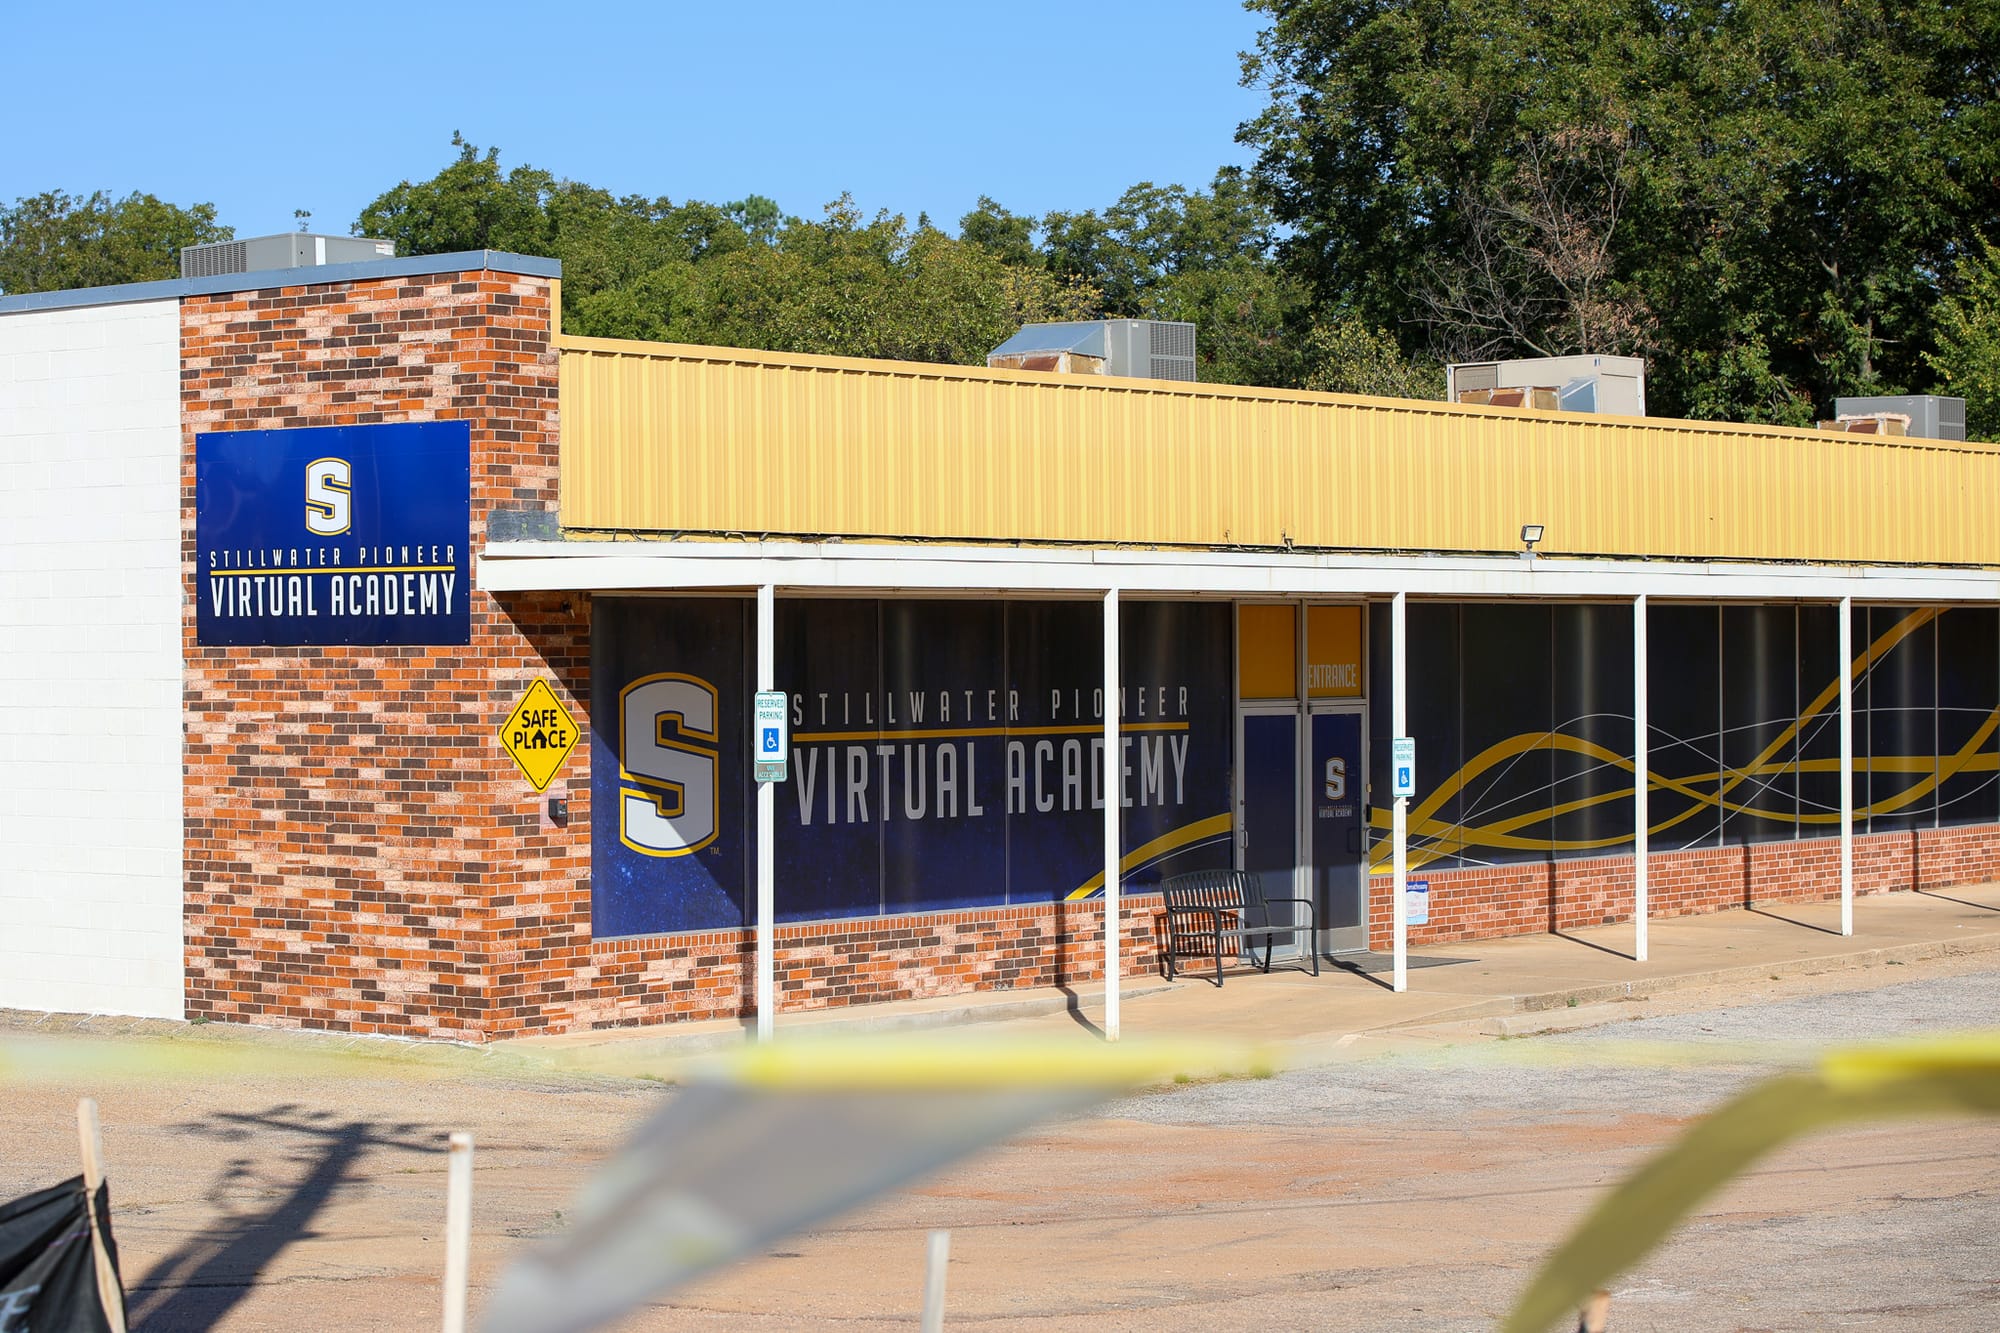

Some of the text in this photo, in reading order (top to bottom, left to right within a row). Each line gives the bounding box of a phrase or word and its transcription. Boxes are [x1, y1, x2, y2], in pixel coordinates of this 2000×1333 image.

[305, 456, 351, 536] S
[210, 545, 454, 568] STILLWATER PIONEER
[210, 573, 456, 617] VIRTUAL ACADEMY
[1308, 664, 1357, 688] ENTRANCE
[521, 709, 558, 728] SAFE
[757, 699, 784, 708] RESERVED
[759, 711, 783, 720] PARKING
[793, 686, 1188, 726] STILLWATER PIONEER
[619, 671, 719, 858] S
[793, 735, 1189, 826] VIRTUAL ACADEMY
